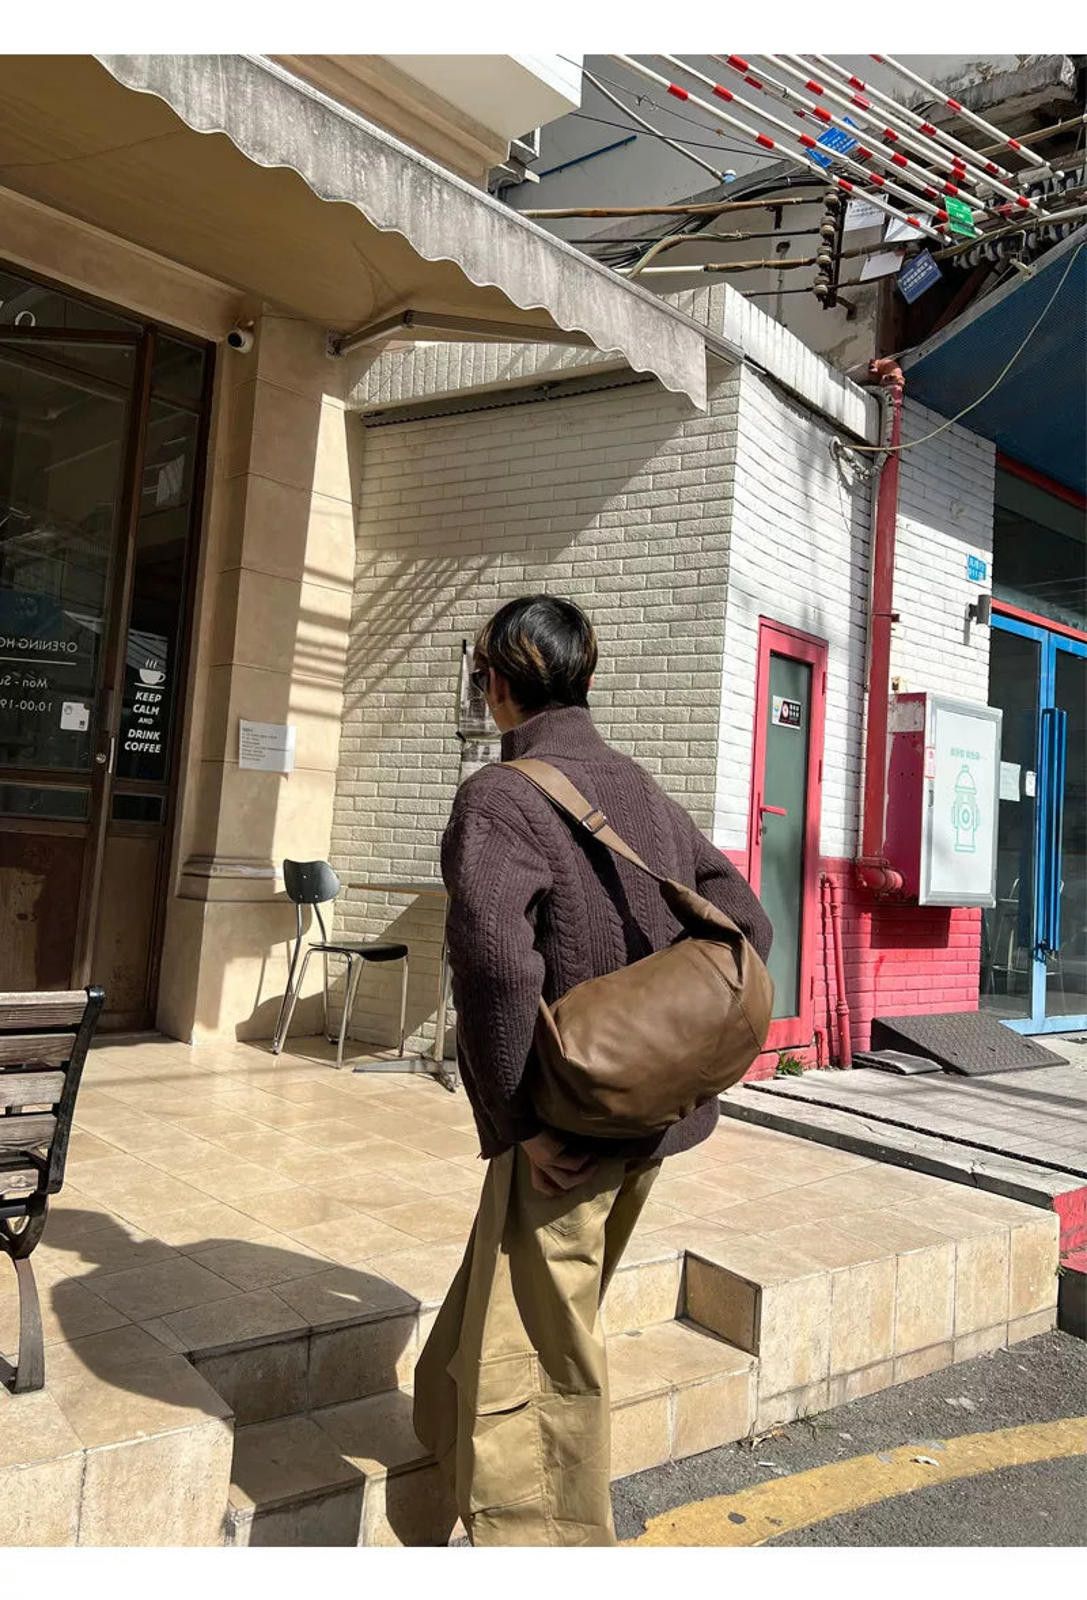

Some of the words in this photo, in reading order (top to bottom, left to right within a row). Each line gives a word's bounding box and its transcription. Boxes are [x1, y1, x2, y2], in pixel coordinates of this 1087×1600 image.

[135, 691, 162, 703] KEEP
[132, 704, 160, 716] CALM
[138, 717, 154, 725] AND
[127, 728, 161, 741] DRINK
[124, 741, 162, 754] COFFEE
